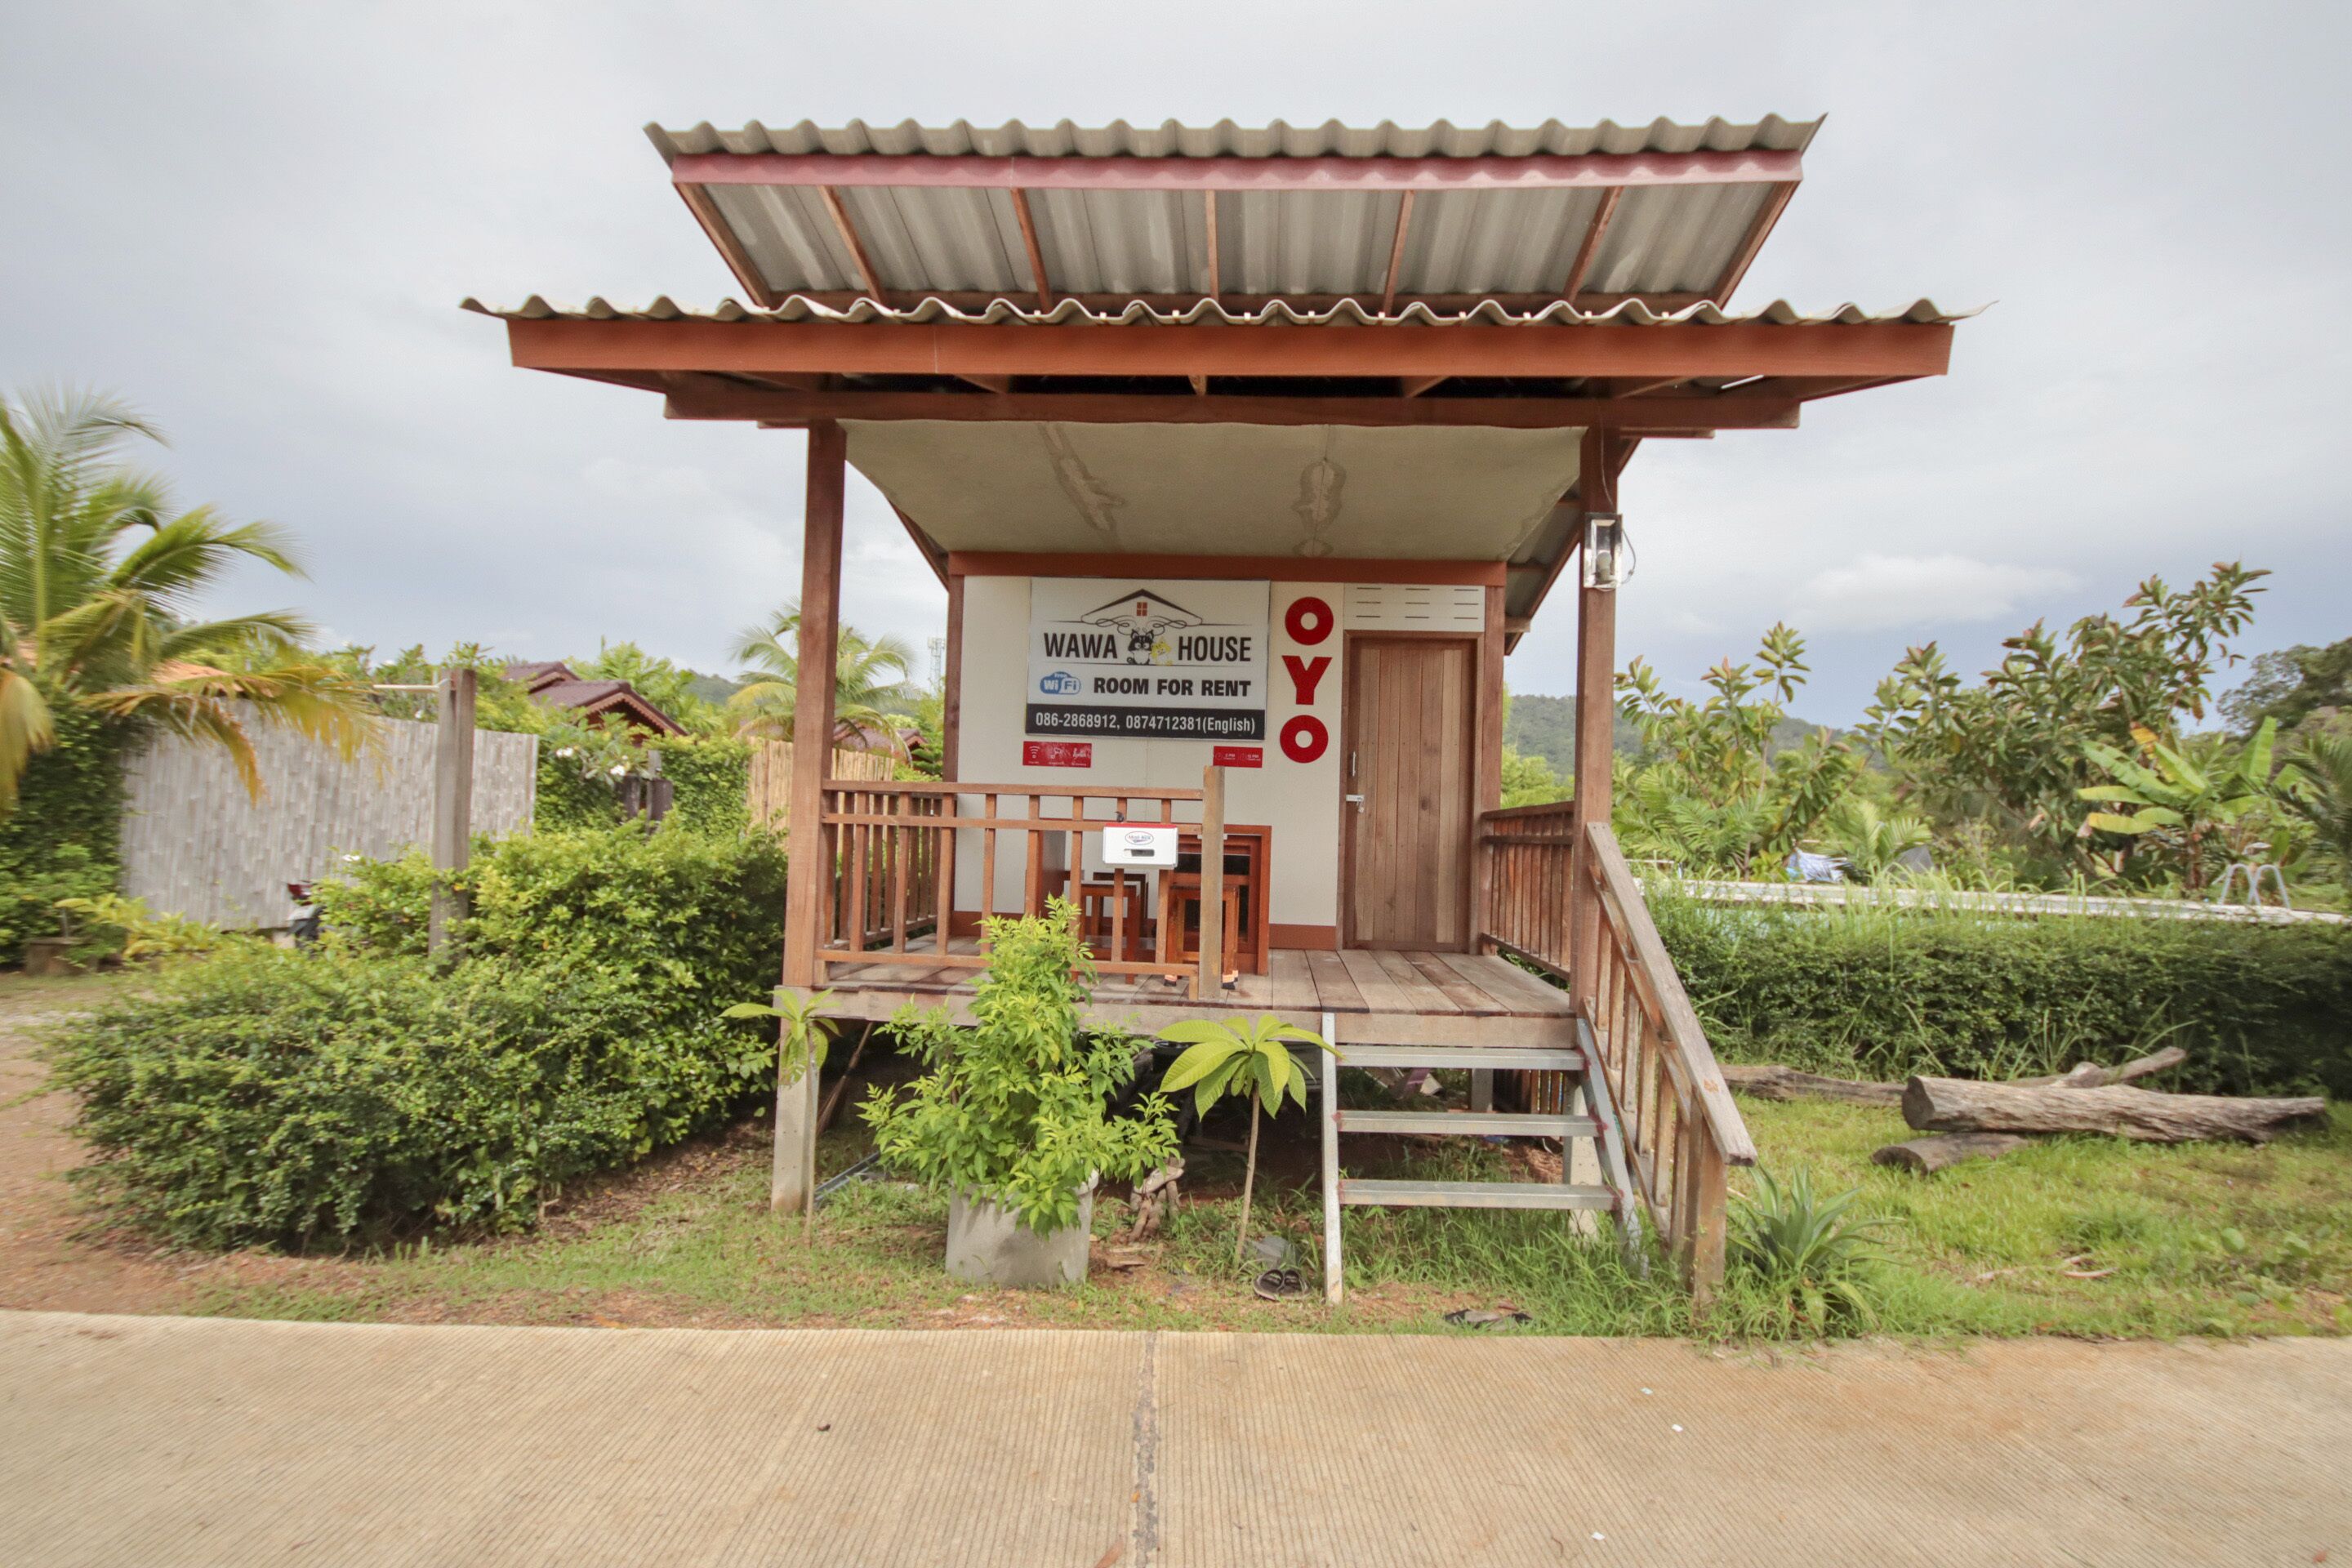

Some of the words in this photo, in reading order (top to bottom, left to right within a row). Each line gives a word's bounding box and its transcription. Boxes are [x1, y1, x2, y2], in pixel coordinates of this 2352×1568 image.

[1044, 632, 1118, 659] WAWA
[1178, 635, 1252, 662] HOUSE
[1093, 676, 1150, 695] ROOM
[1156, 678, 1194, 696] FOR
[1200, 679, 1252, 697] RENT
[1280, 596, 1334, 764] OYO
[1036, 711, 1120, 730] 086-2868912,
[1125, 715, 1255, 735] 0874712381(English)
